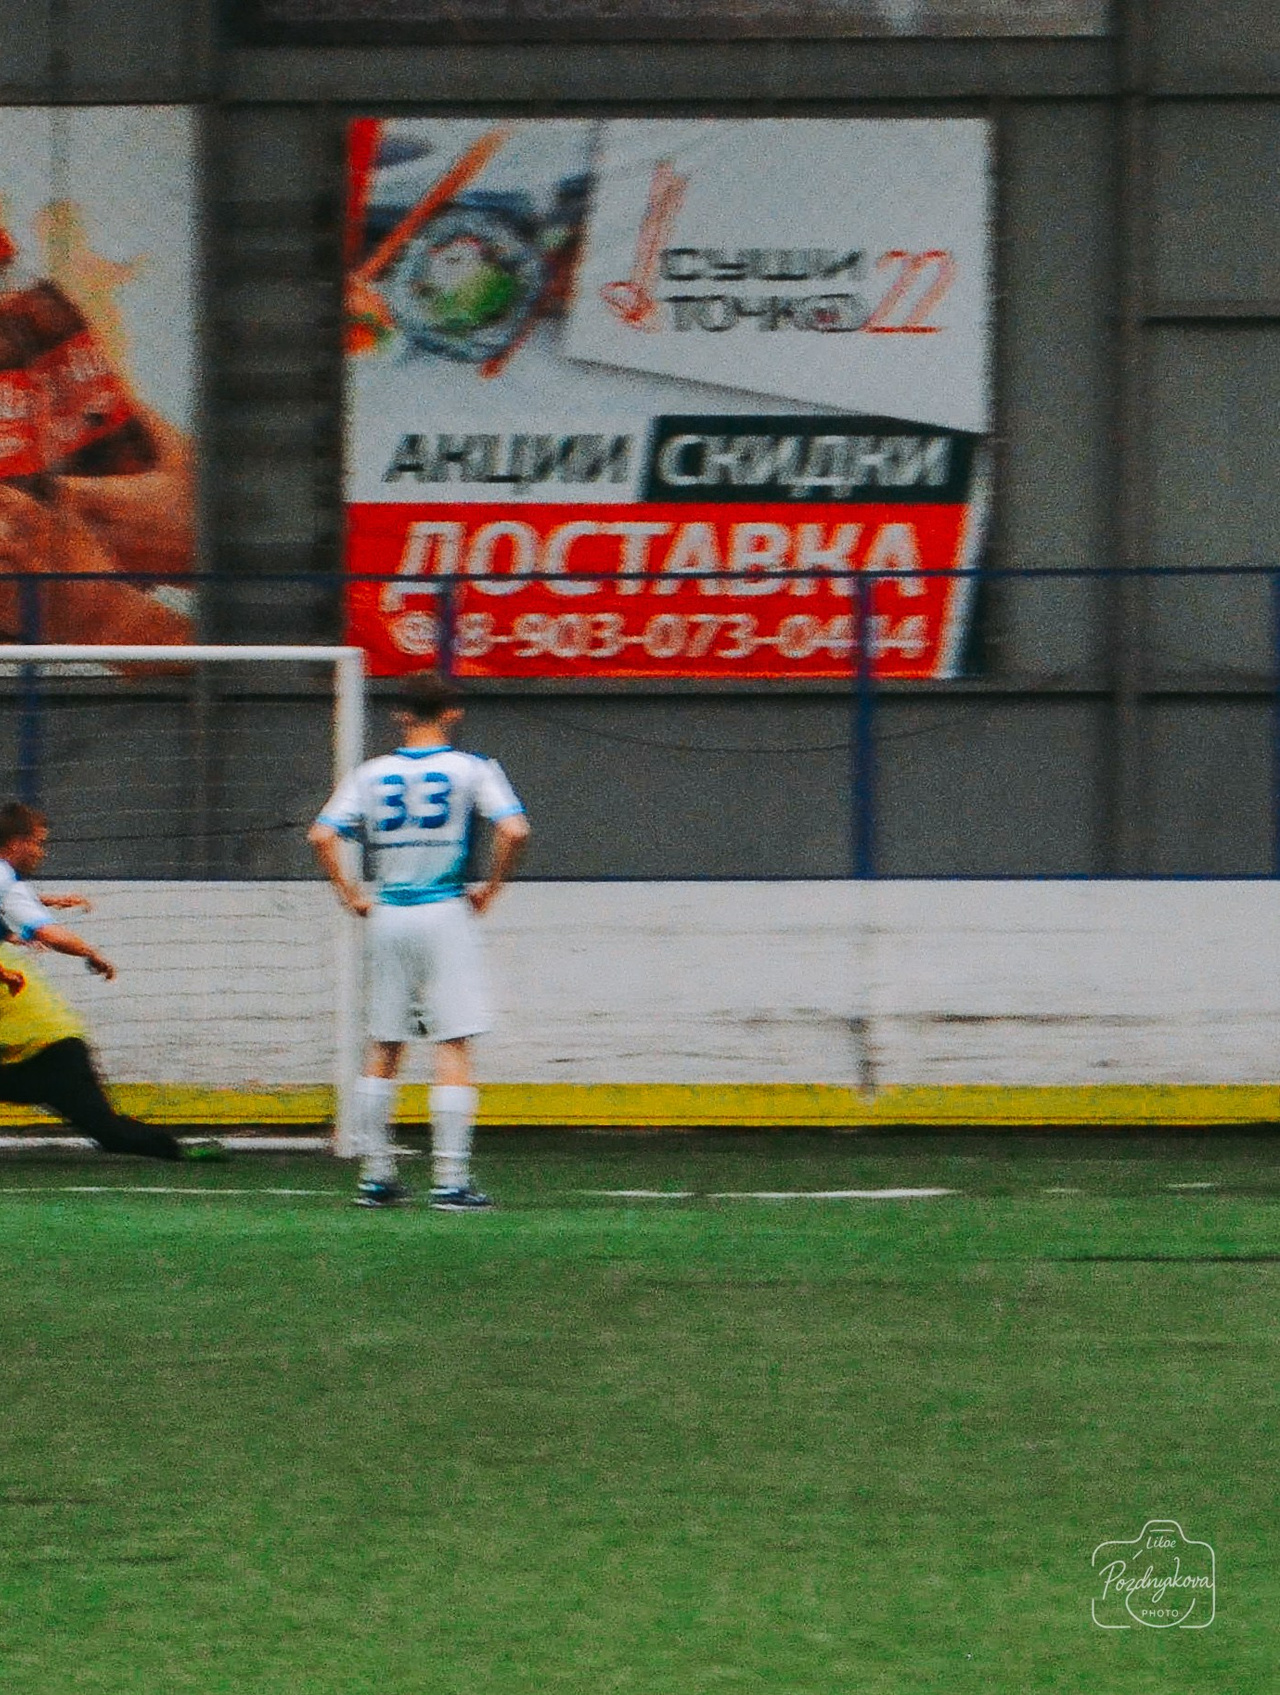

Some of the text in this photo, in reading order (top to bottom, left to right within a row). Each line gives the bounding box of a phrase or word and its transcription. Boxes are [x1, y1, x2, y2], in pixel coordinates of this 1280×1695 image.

[662, 247, 864, 282] СУШИ
[866, 247, 958, 333] 22
[382, 432, 956, 498] АКЦИИ СКИДКИ
[380, 520, 928, 613] ДОСТАВКА
[378, 771, 450, 832] 33
